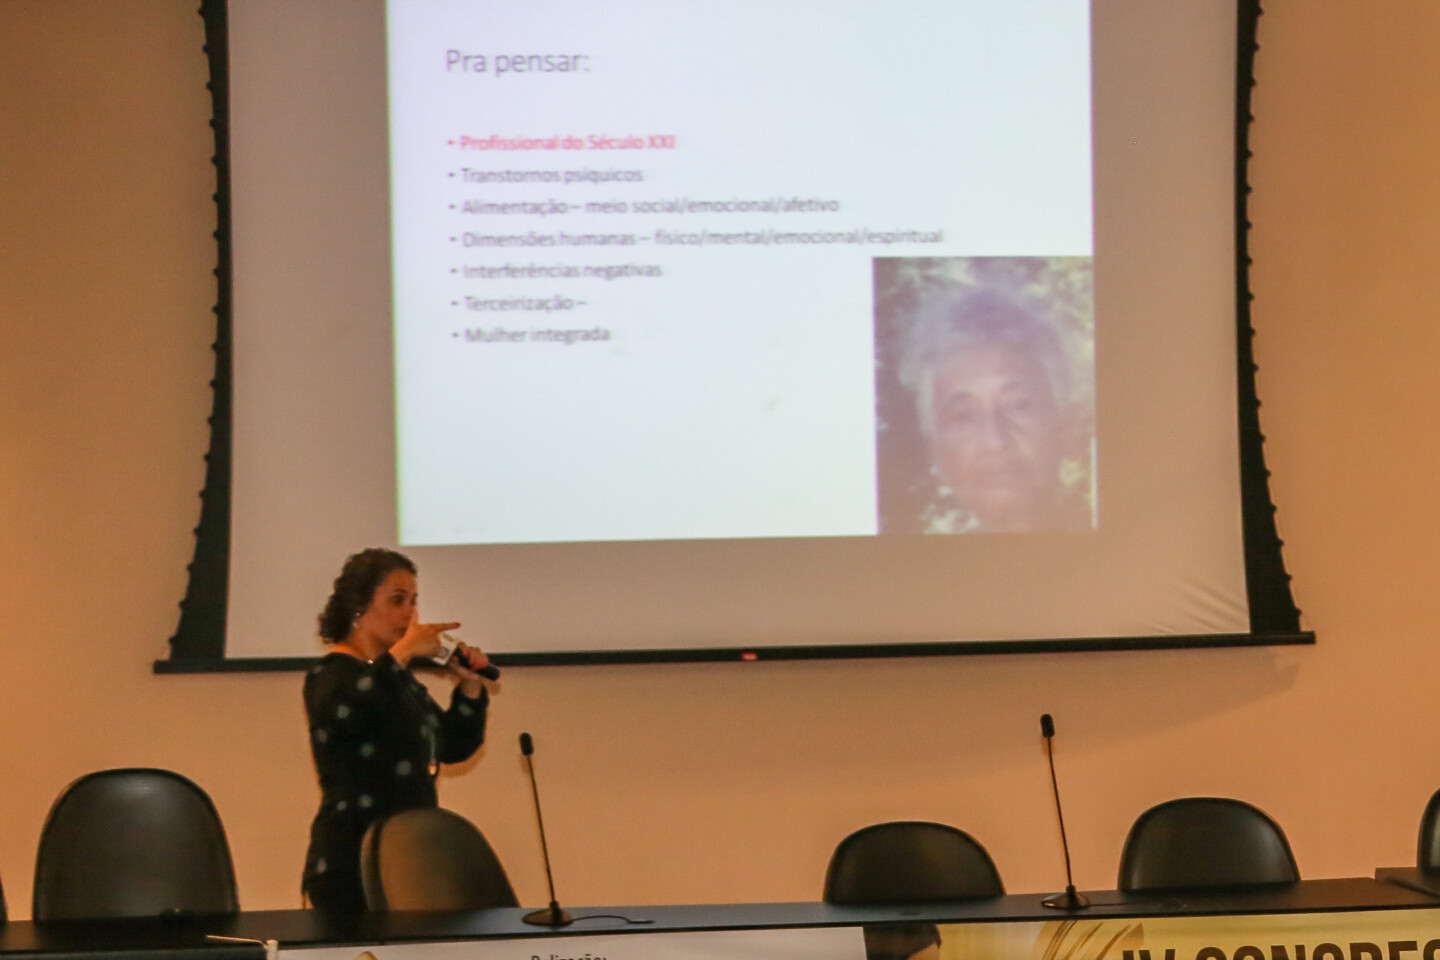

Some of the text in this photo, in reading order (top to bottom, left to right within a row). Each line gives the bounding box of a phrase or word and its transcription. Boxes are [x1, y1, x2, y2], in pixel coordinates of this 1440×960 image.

[446, 49, 590, 77] Pra pensar:
[460, 134, 675, 150] Profissional do Século XXI
[461, 168, 559, 182] Transtornos
[462, 199, 568, 217] Alimentação
[585, 200, 628, 213] meio
[463, 231, 557, 247] Dimensões
[559, 231, 637, 246] humanas
[583, 264, 663, 281] negativas
[464, 295, 574, 313] Terceirização
[465, 325, 611, 345] Mulher integrada
